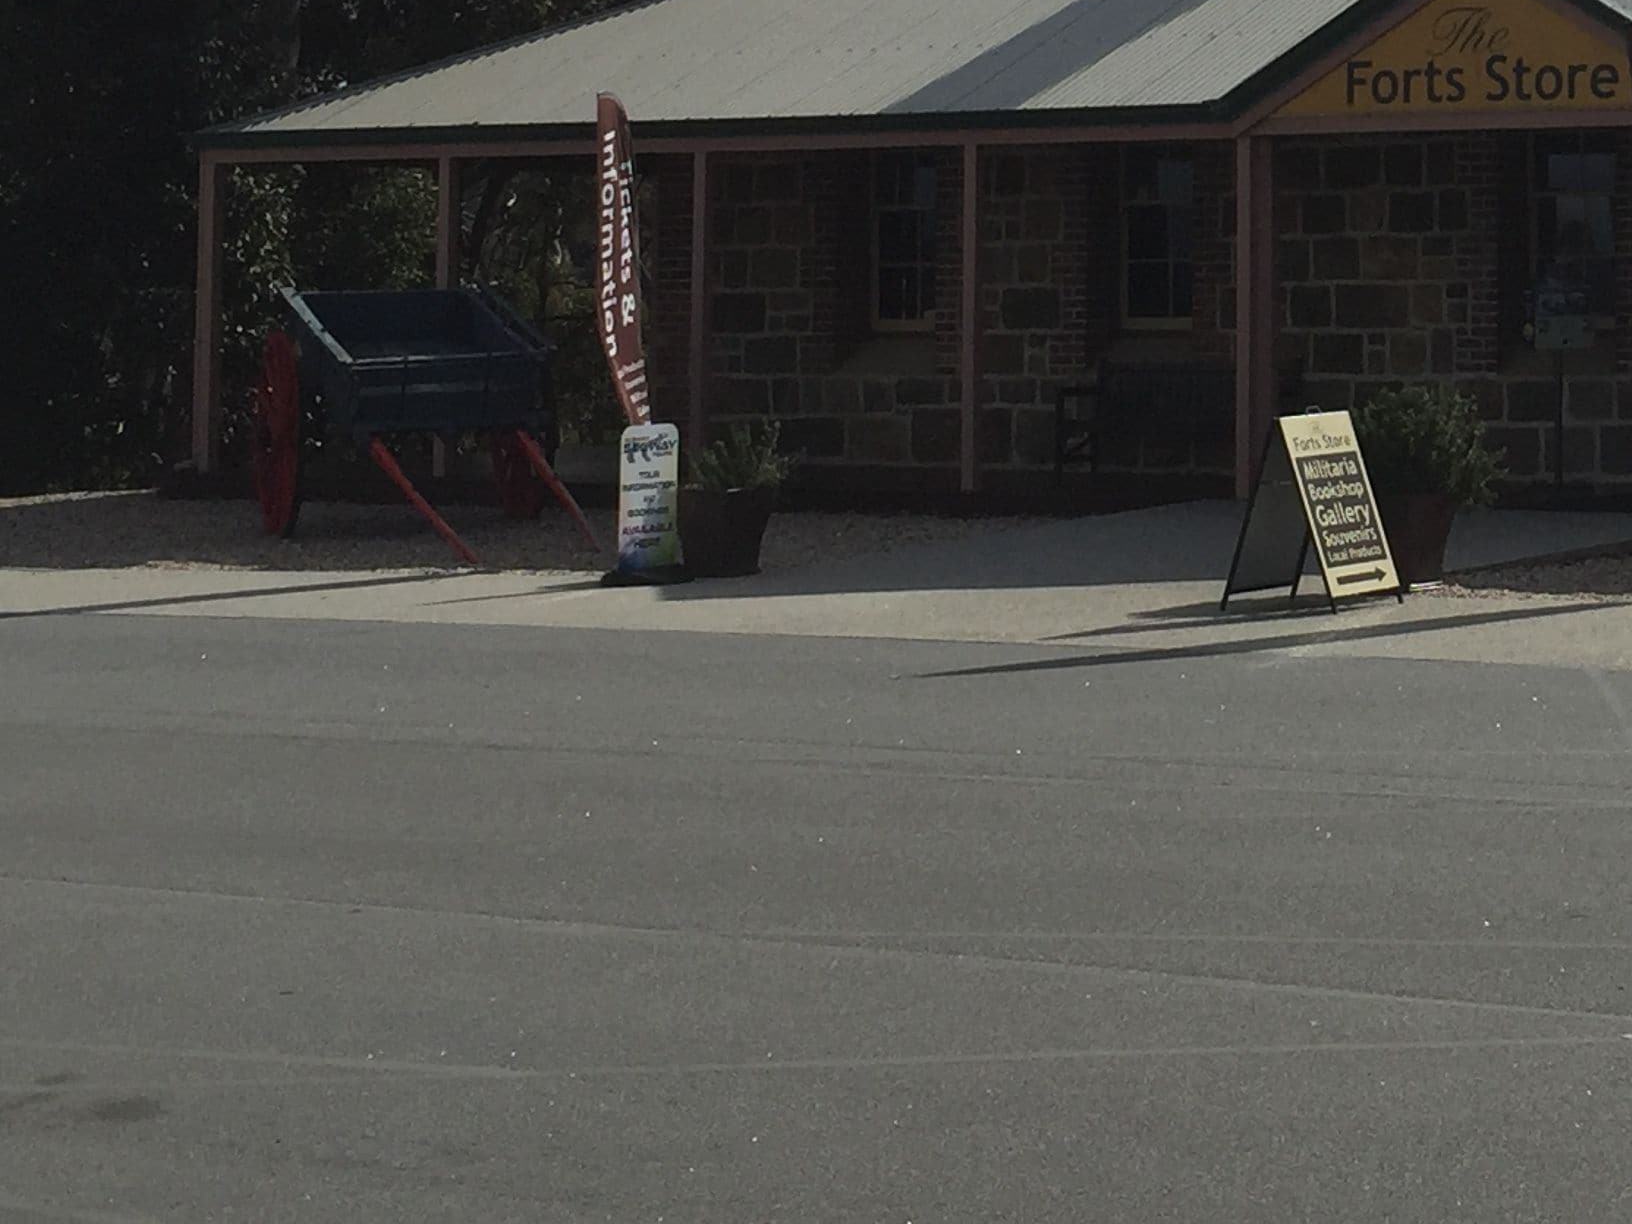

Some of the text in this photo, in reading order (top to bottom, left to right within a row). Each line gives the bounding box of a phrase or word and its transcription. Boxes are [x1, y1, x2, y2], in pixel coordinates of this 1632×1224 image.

[1426, 7, 1510, 57] The
[1346, 54, 1620, 106] Forts Store
[602, 129, 618, 358] Information
[1293, 434, 1352, 452] Forts Store
[1303, 457, 1358, 480] Militaria
[1308, 480, 1365, 501] Bookshop
[1316, 501, 1370, 527] Gallery
[1322, 525, 1377, 547] Souvenirs
[1327, 545, 1382, 562] Local Products
